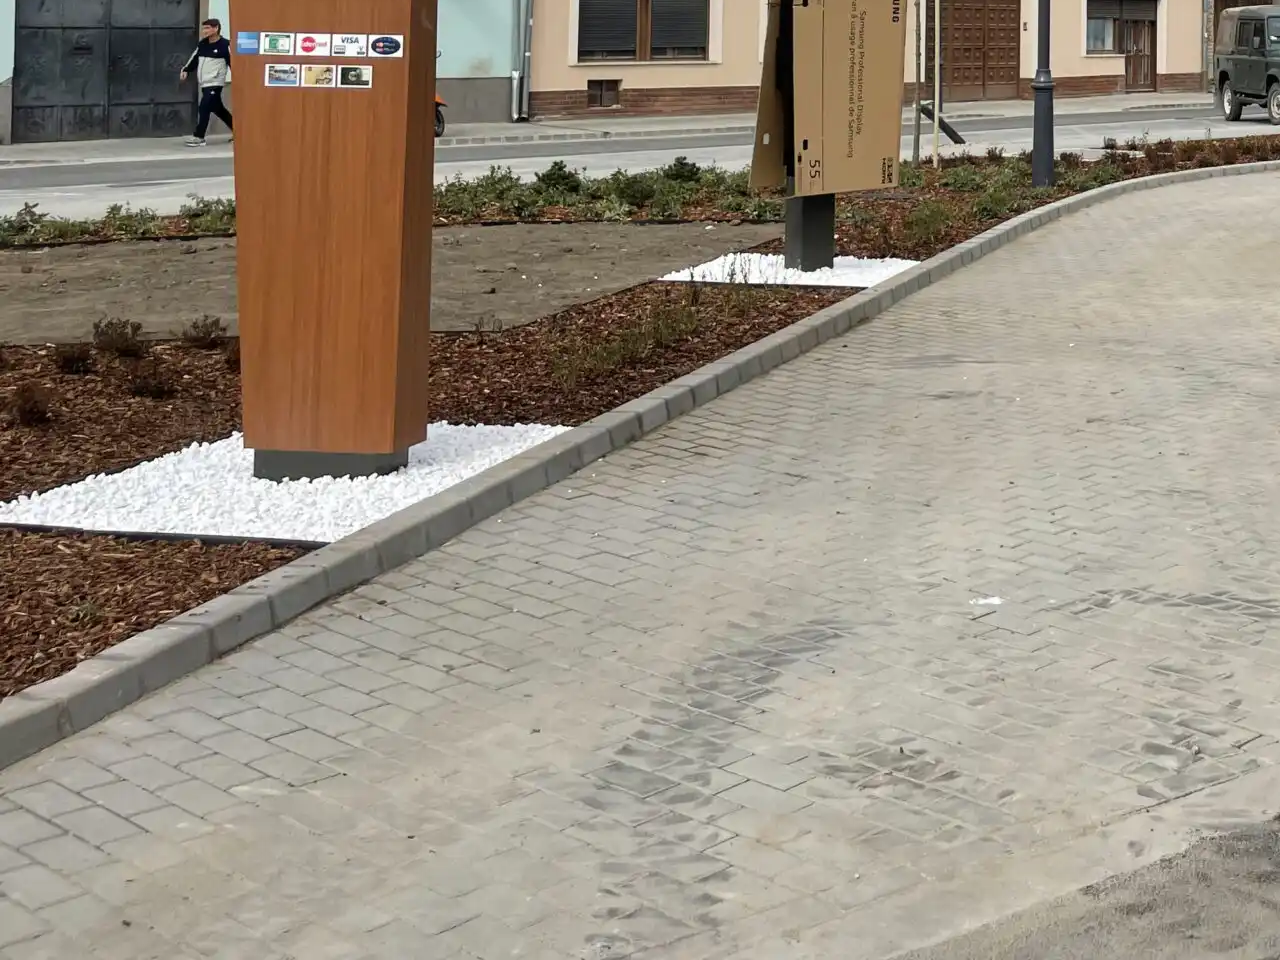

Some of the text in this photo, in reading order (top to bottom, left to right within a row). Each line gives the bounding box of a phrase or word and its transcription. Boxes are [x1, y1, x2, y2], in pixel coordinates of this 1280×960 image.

[341, 36, 359, 44] VISA
[855, 10, 867, 135] Samsung Professional Display
[847, 119, 855, 158] Samsung
[809, 159, 821, 179] 55
